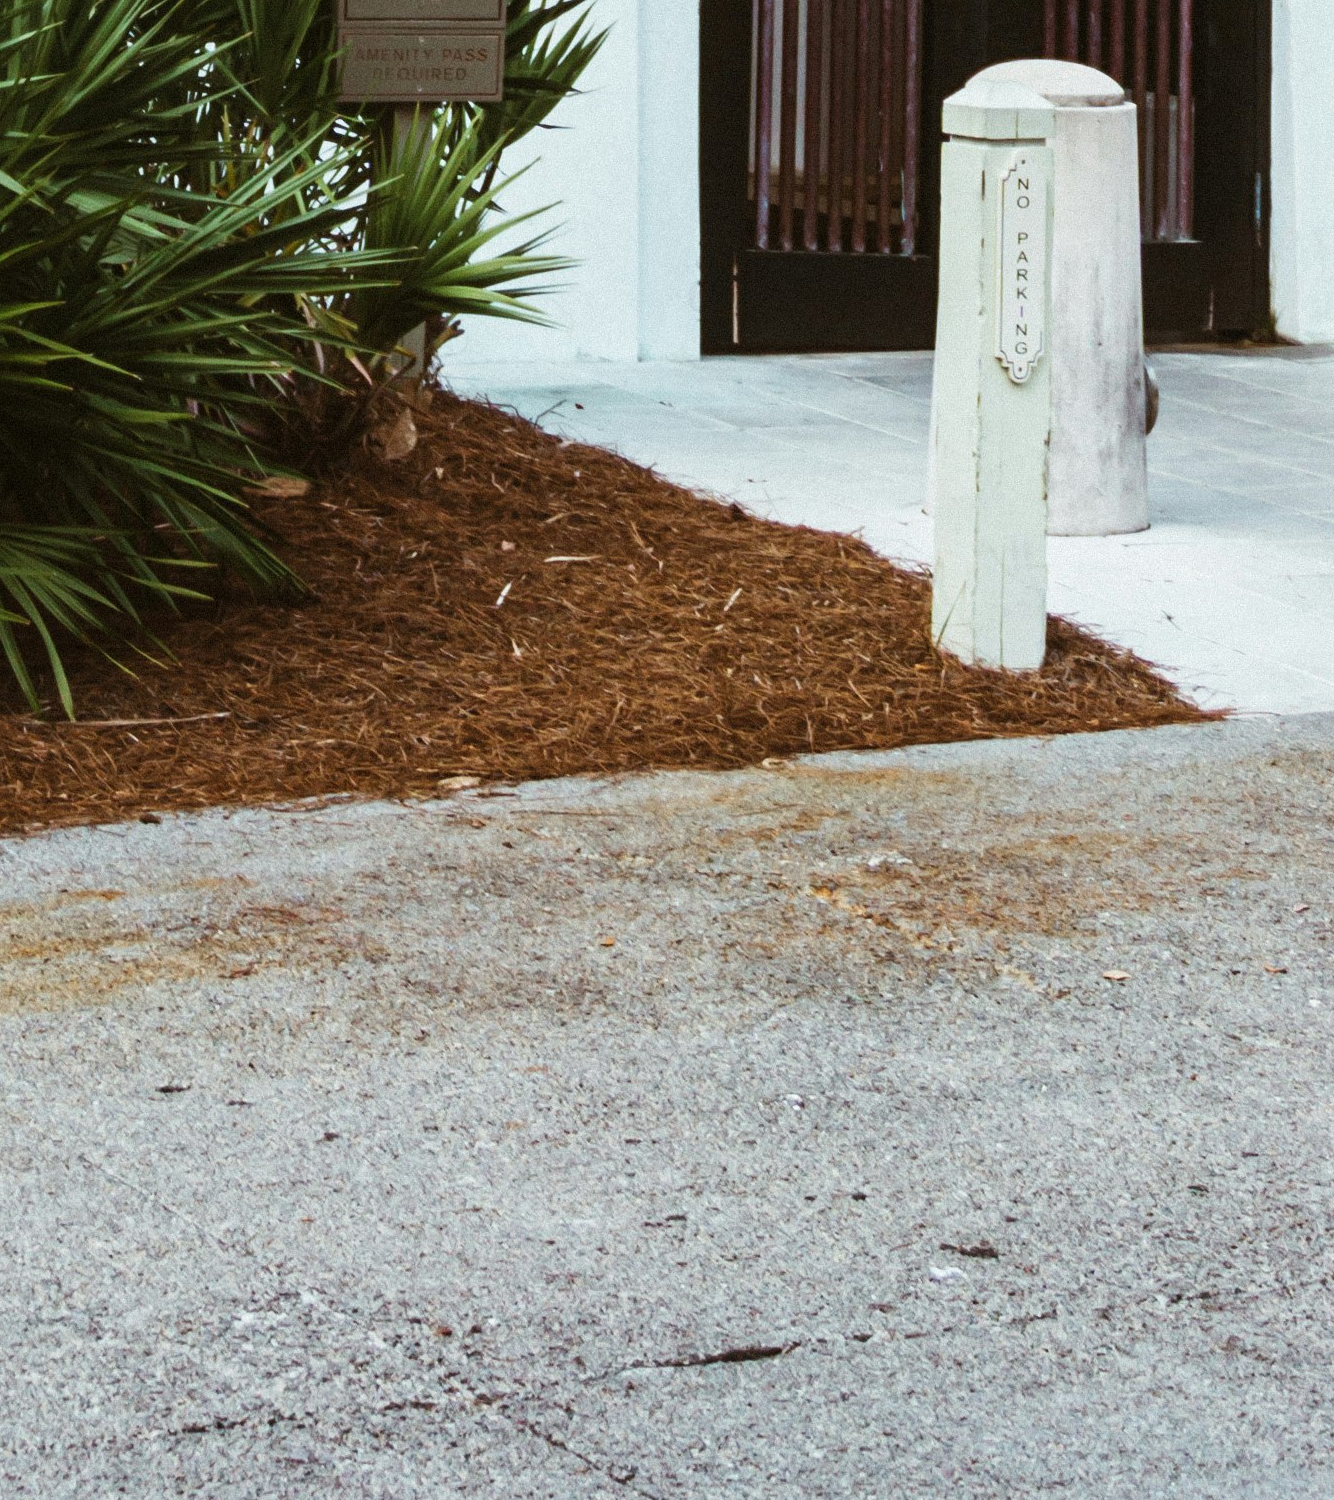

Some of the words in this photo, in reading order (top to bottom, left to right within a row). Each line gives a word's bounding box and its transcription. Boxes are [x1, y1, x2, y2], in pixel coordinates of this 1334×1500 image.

[354, 48, 432, 62] AMENITY
[442, 48, 488, 62] PASS
[373, 68, 467, 82] REQUIRED
[1017, 178, 1030, 209] NO
[1014, 232, 1029, 355] PARKING
